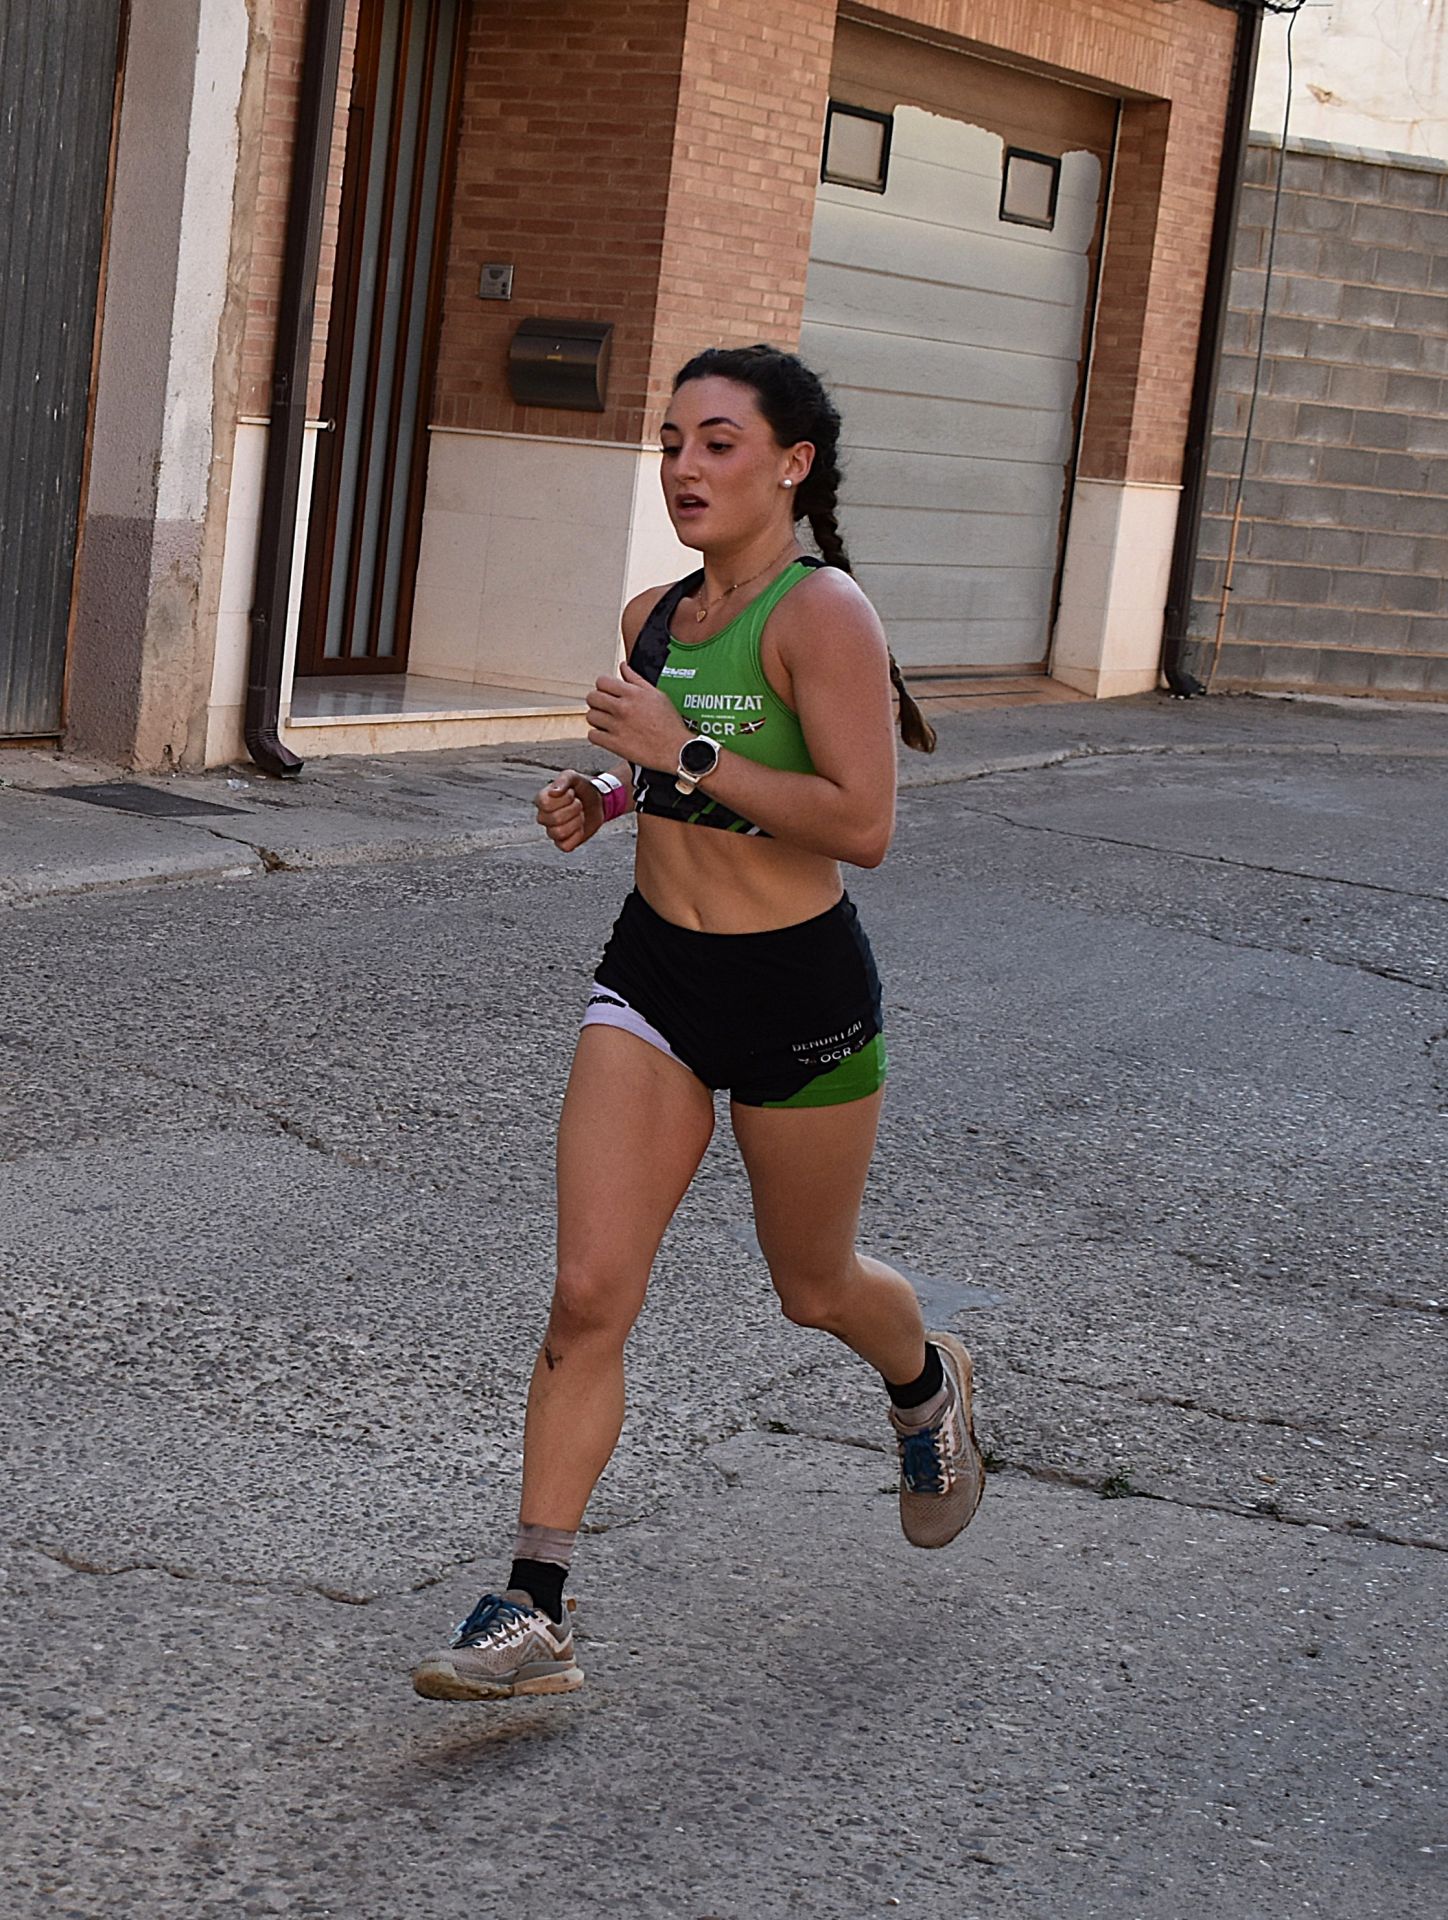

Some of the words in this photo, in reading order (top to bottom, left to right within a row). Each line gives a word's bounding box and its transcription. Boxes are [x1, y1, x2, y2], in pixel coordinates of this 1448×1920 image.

[683, 694, 764, 711] DENONTZAT
[700, 721, 736, 736] OCR
[820, 1046, 852, 1063] OCR
